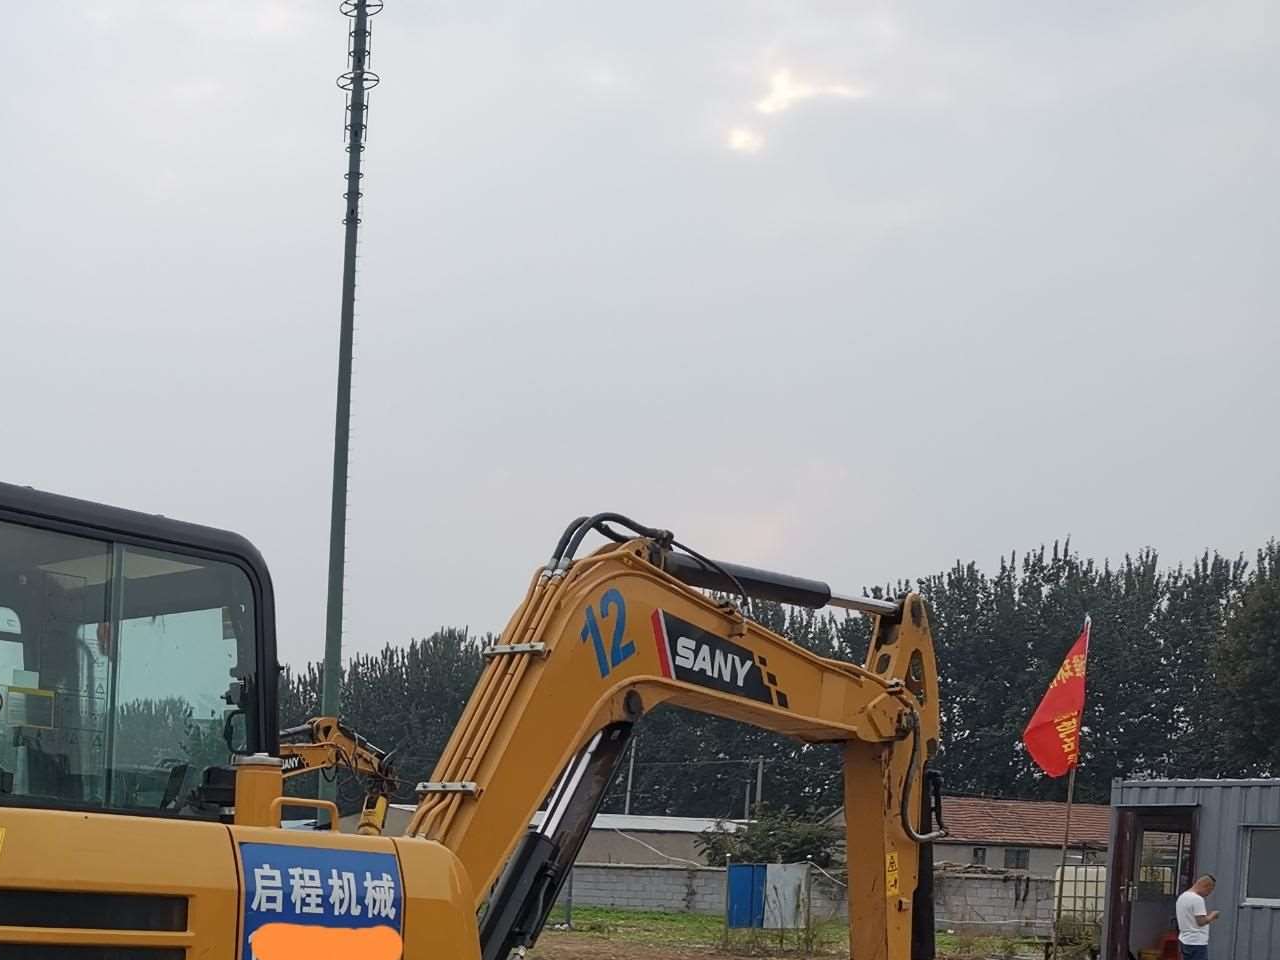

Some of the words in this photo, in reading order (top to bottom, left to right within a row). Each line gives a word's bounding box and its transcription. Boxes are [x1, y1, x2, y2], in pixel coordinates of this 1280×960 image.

[580, 588, 636, 679] 12
[674, 636, 754, 687] SANY
[251, 863, 397, 921] 启程机械
